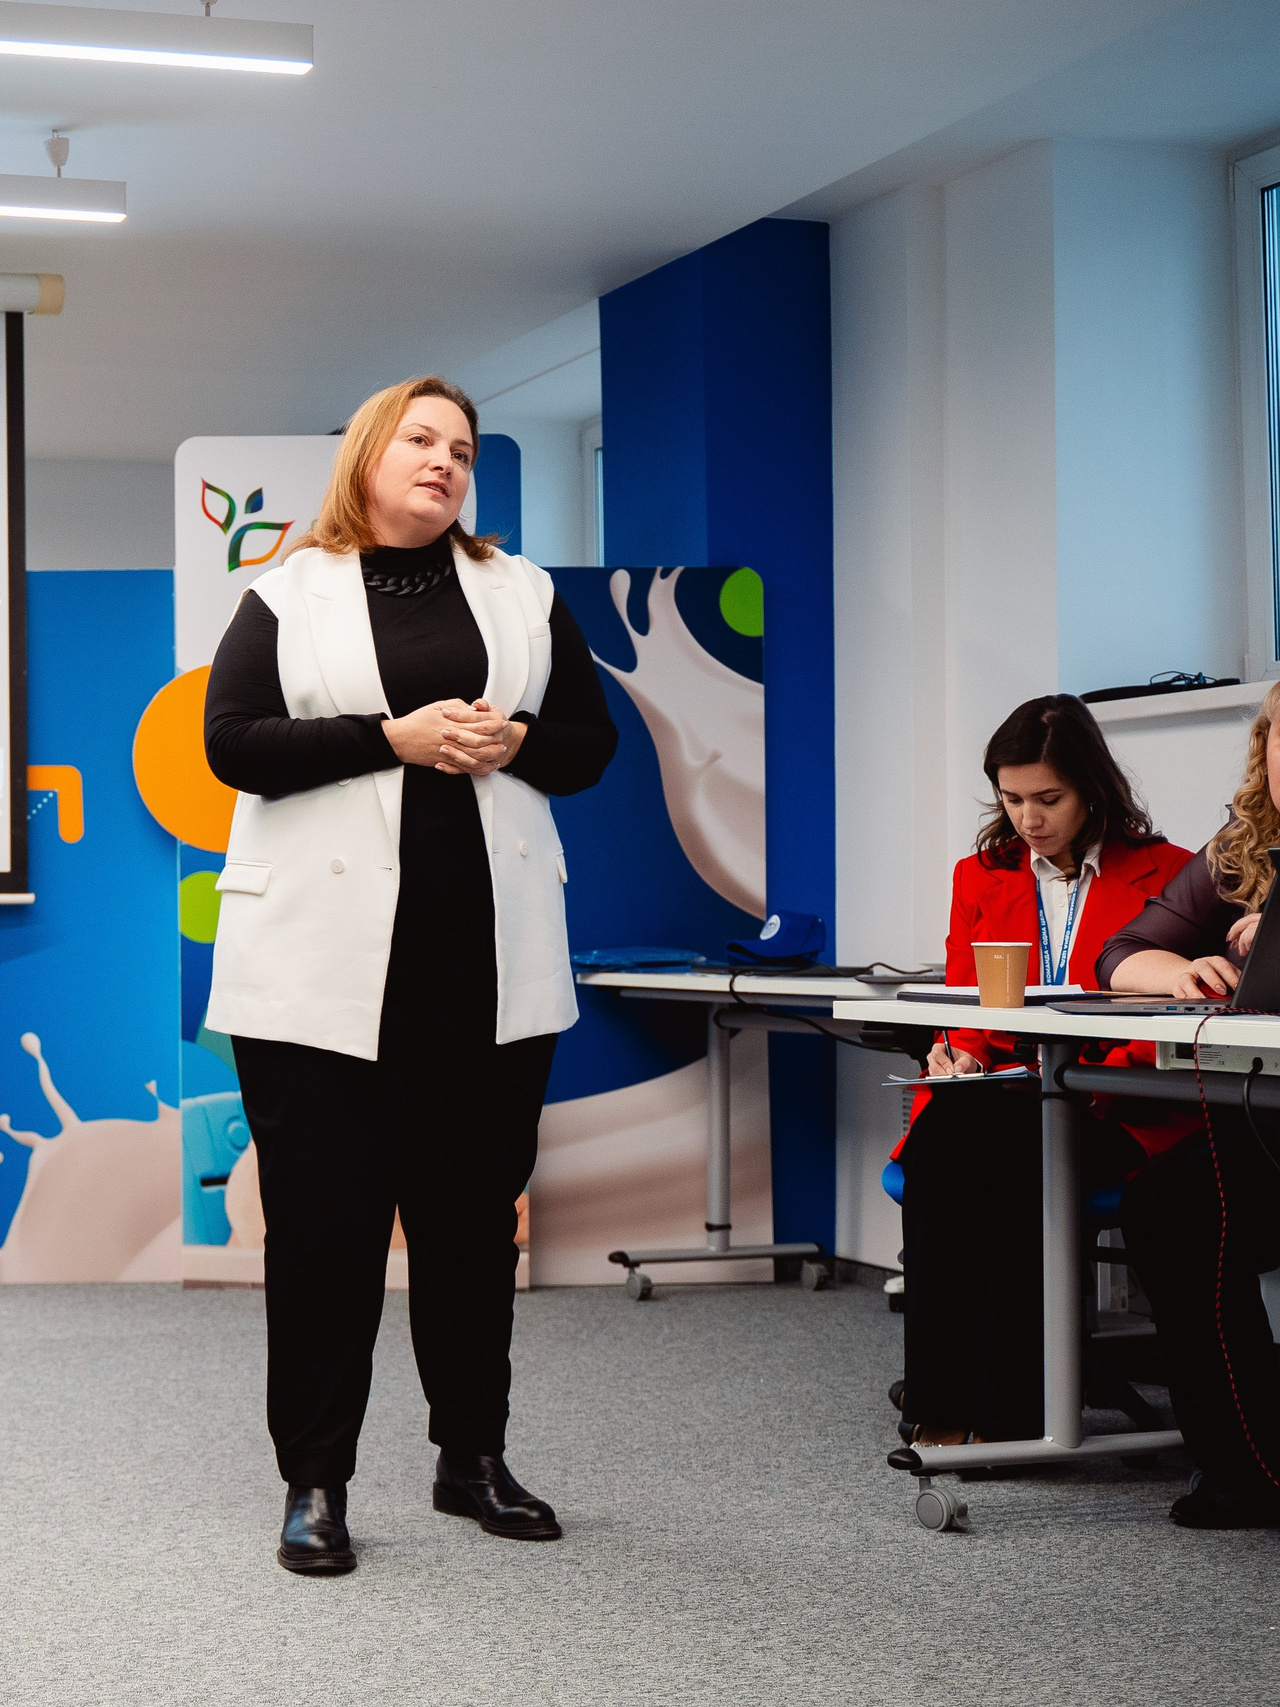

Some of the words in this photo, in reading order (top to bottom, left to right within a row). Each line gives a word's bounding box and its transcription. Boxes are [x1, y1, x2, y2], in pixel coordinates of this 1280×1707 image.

[1068, 893, 1076, 925] КОМАНДА
[1063, 930, 1071, 949] ОДНА
[1044, 950, 1052, 983] КОМАНДА
[1060, 950, 1068, 968] ЦЕЛЬ
